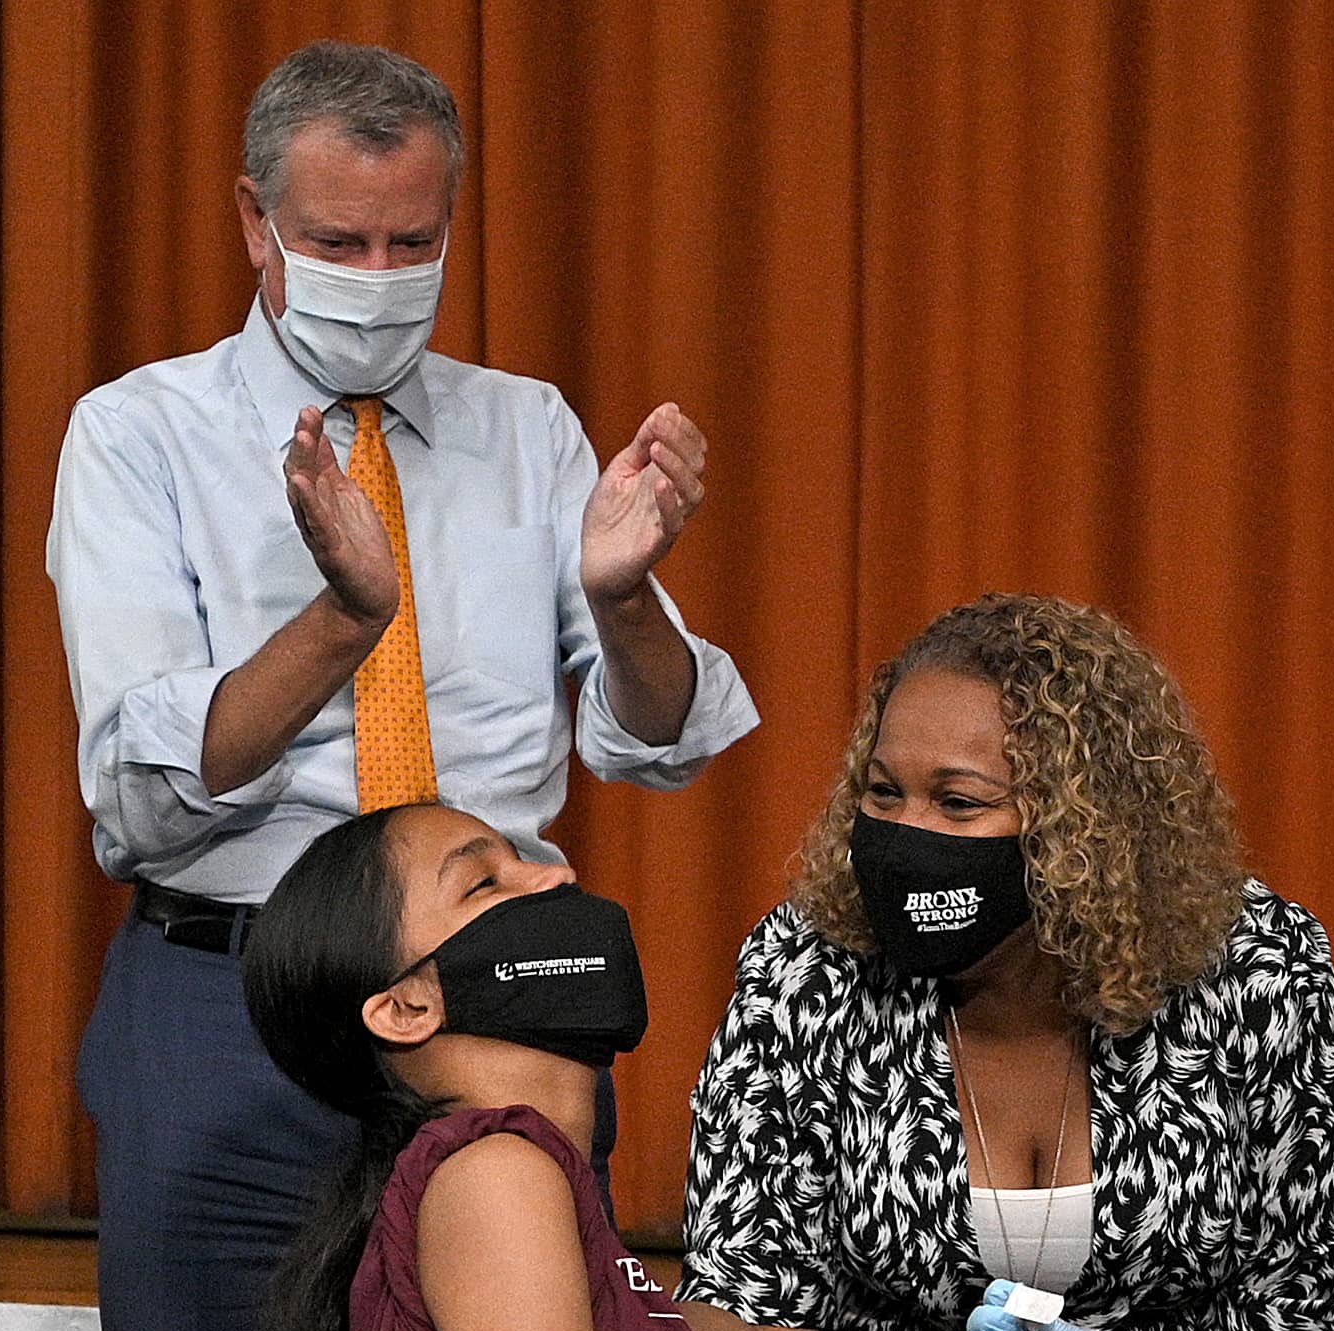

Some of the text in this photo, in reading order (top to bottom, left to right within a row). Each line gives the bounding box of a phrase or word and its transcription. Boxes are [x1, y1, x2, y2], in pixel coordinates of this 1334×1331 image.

[903, 887, 984, 911] BRONX
[910, 904, 978, 922] STRONG
[514, 958, 573, 971] WESTCHESTER
[574, 957, 606, 967] SQUARE
[538, 966, 586, 976] ACADEMY
